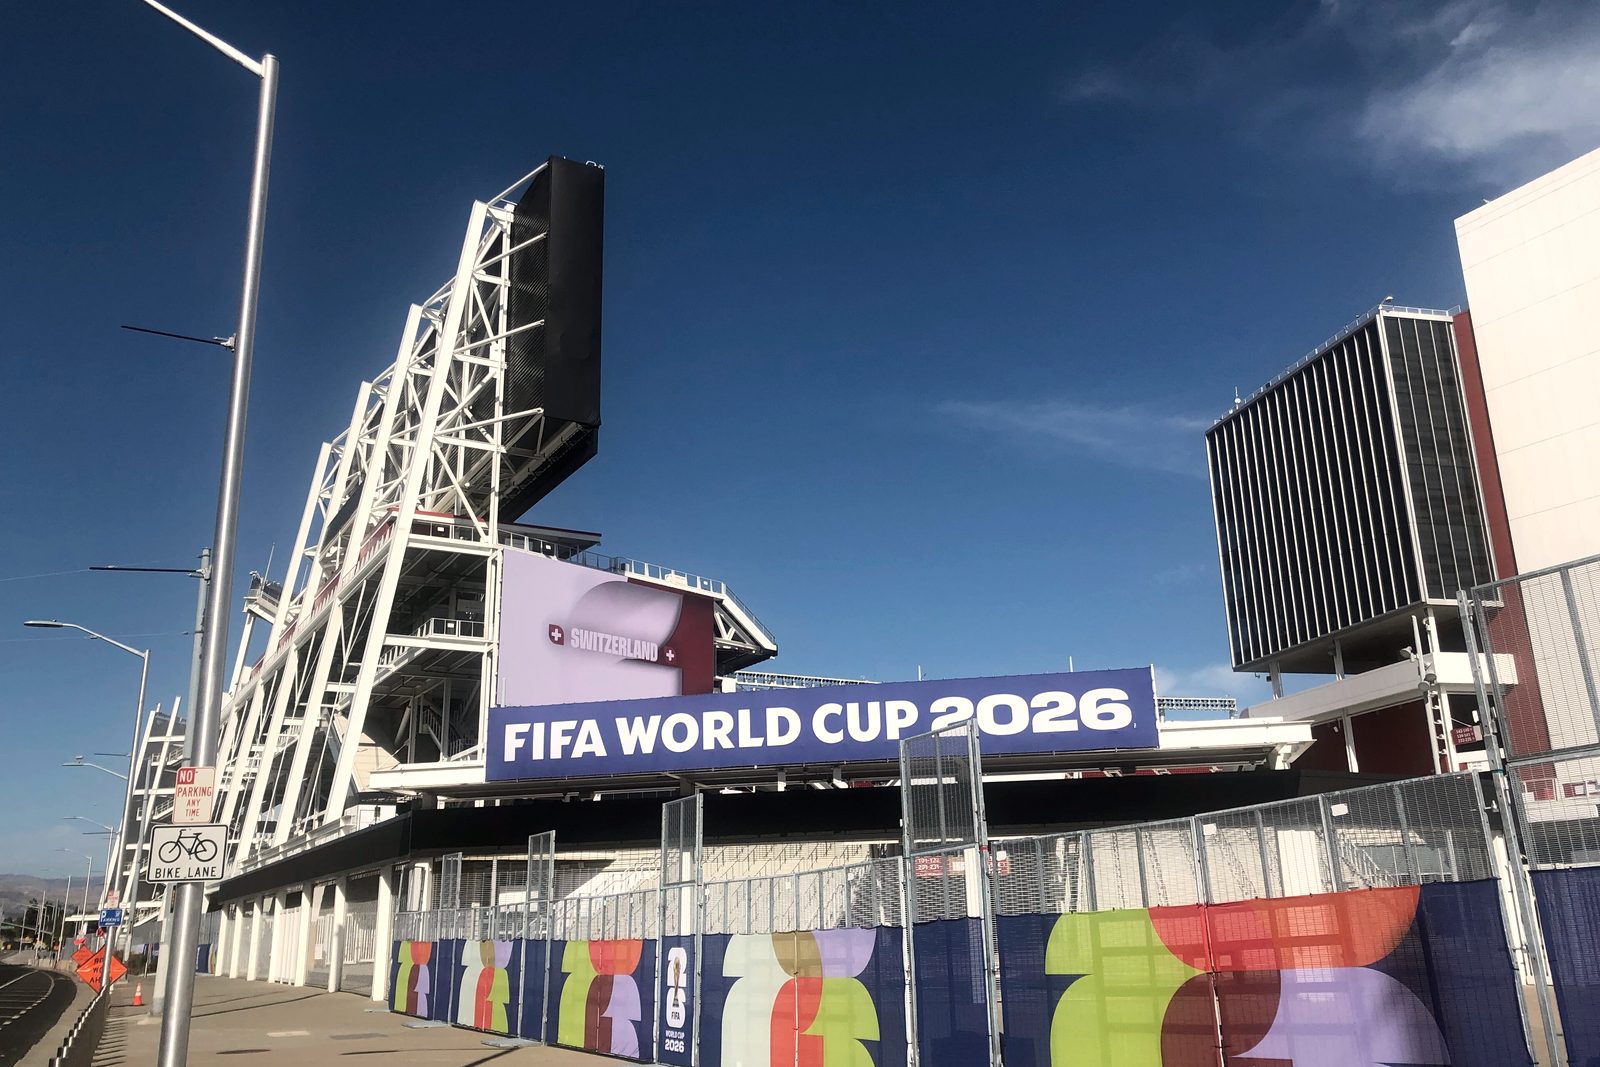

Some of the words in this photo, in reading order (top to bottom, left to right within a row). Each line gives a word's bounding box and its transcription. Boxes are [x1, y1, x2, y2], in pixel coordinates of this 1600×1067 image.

[570, 627, 659, 662] SWITZERLAND
[503, 719, 608, 762] FIFA
[615, 706, 801, 755] WORLD
[811, 700, 919, 744] CUP
[929, 688, 1132, 738] 2026
[180, 770, 193, 783] NO
[177, 786, 212, 797] PARKING
[186, 799, 201, 807] ANY
[185, 808, 200, 817] TIME
[155, 867, 181, 879] BIKE
[188, 866, 217, 878] LANE
[671, 1011, 681, 1021] FIFA
[665, 1029, 677, 1039] WORLD
[665, 1039, 685, 1053] 2026
